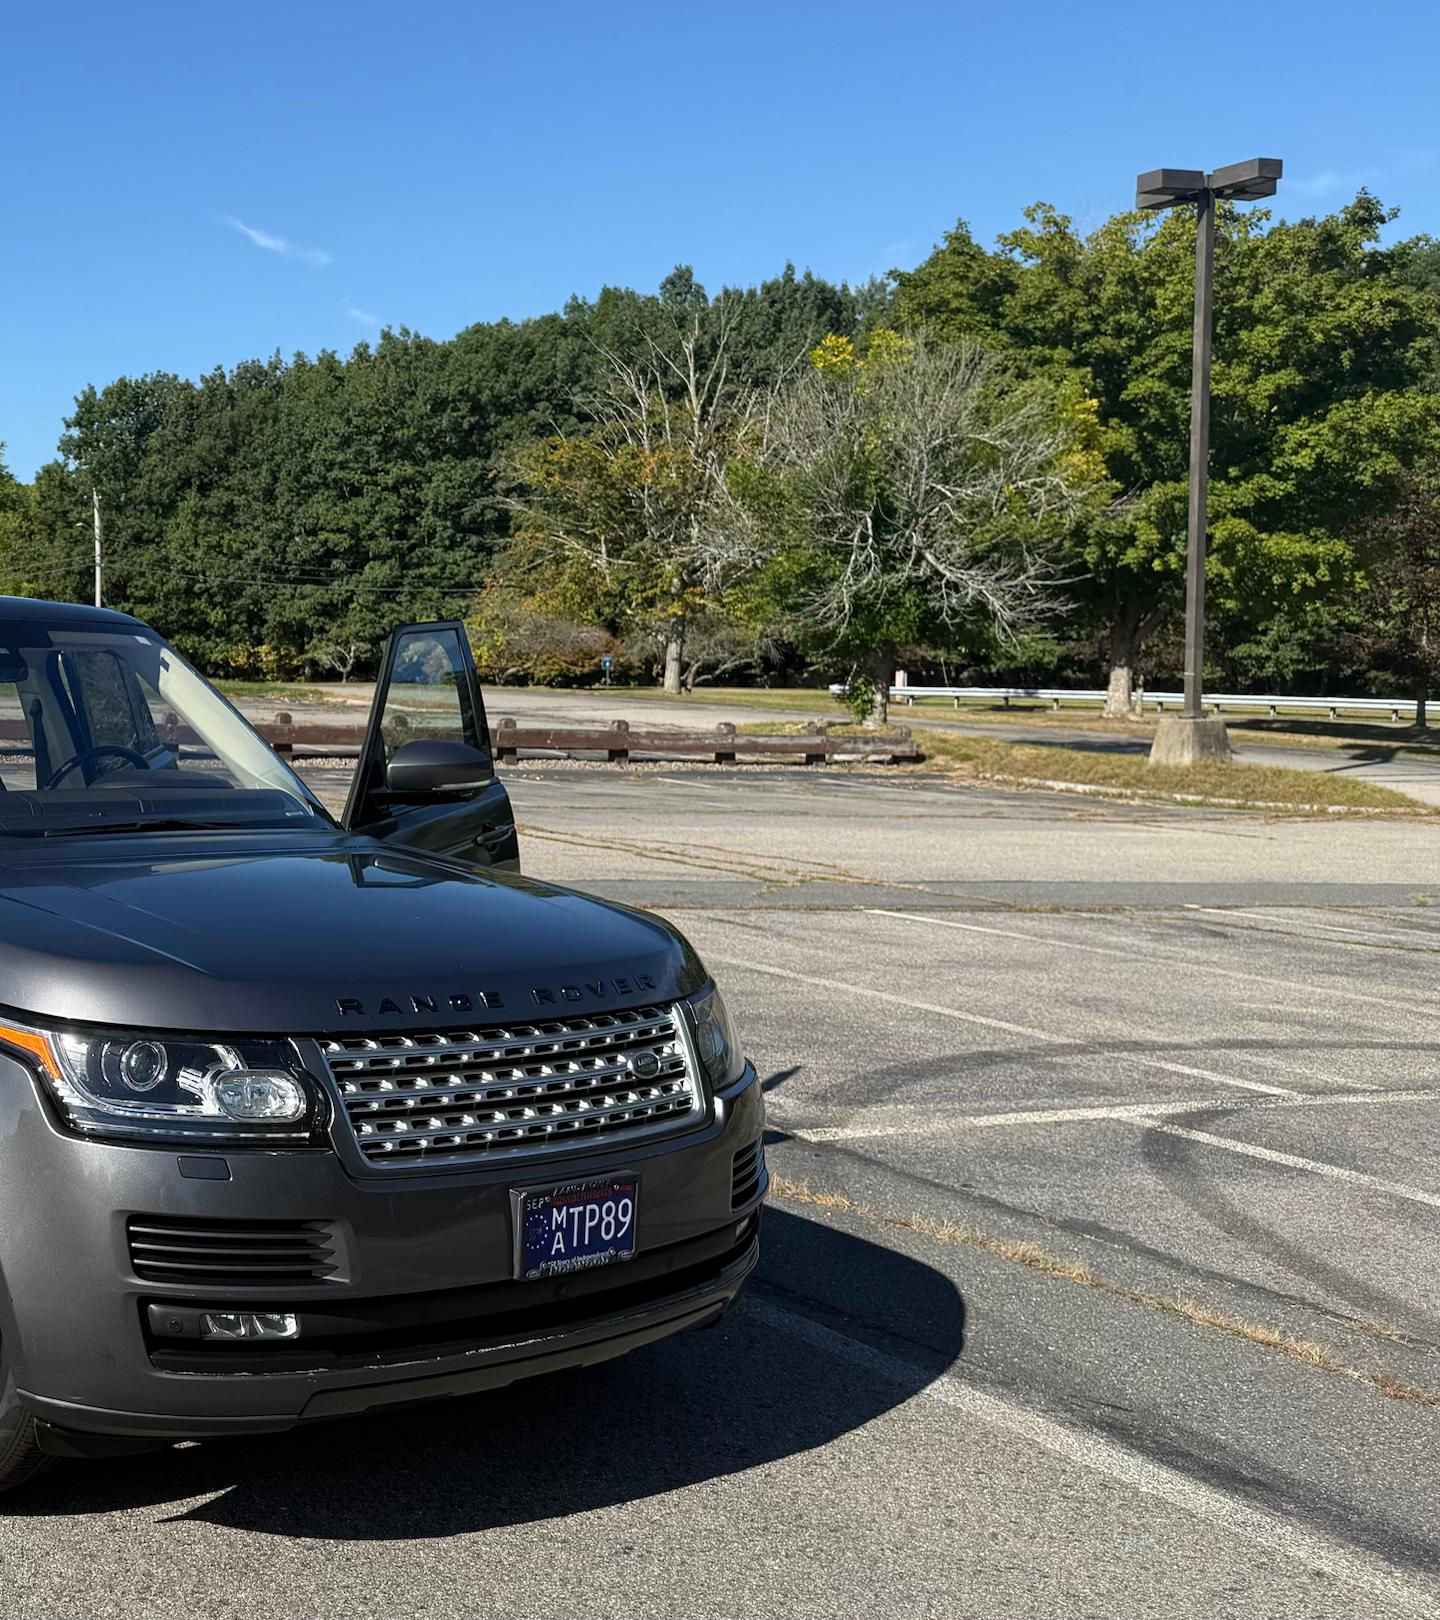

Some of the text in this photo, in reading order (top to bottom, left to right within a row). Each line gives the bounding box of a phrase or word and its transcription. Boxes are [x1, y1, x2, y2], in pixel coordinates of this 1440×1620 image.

[336, 974, 656, 1016] RANGE ROVER
[526, 1198, 545, 1211] SEP
